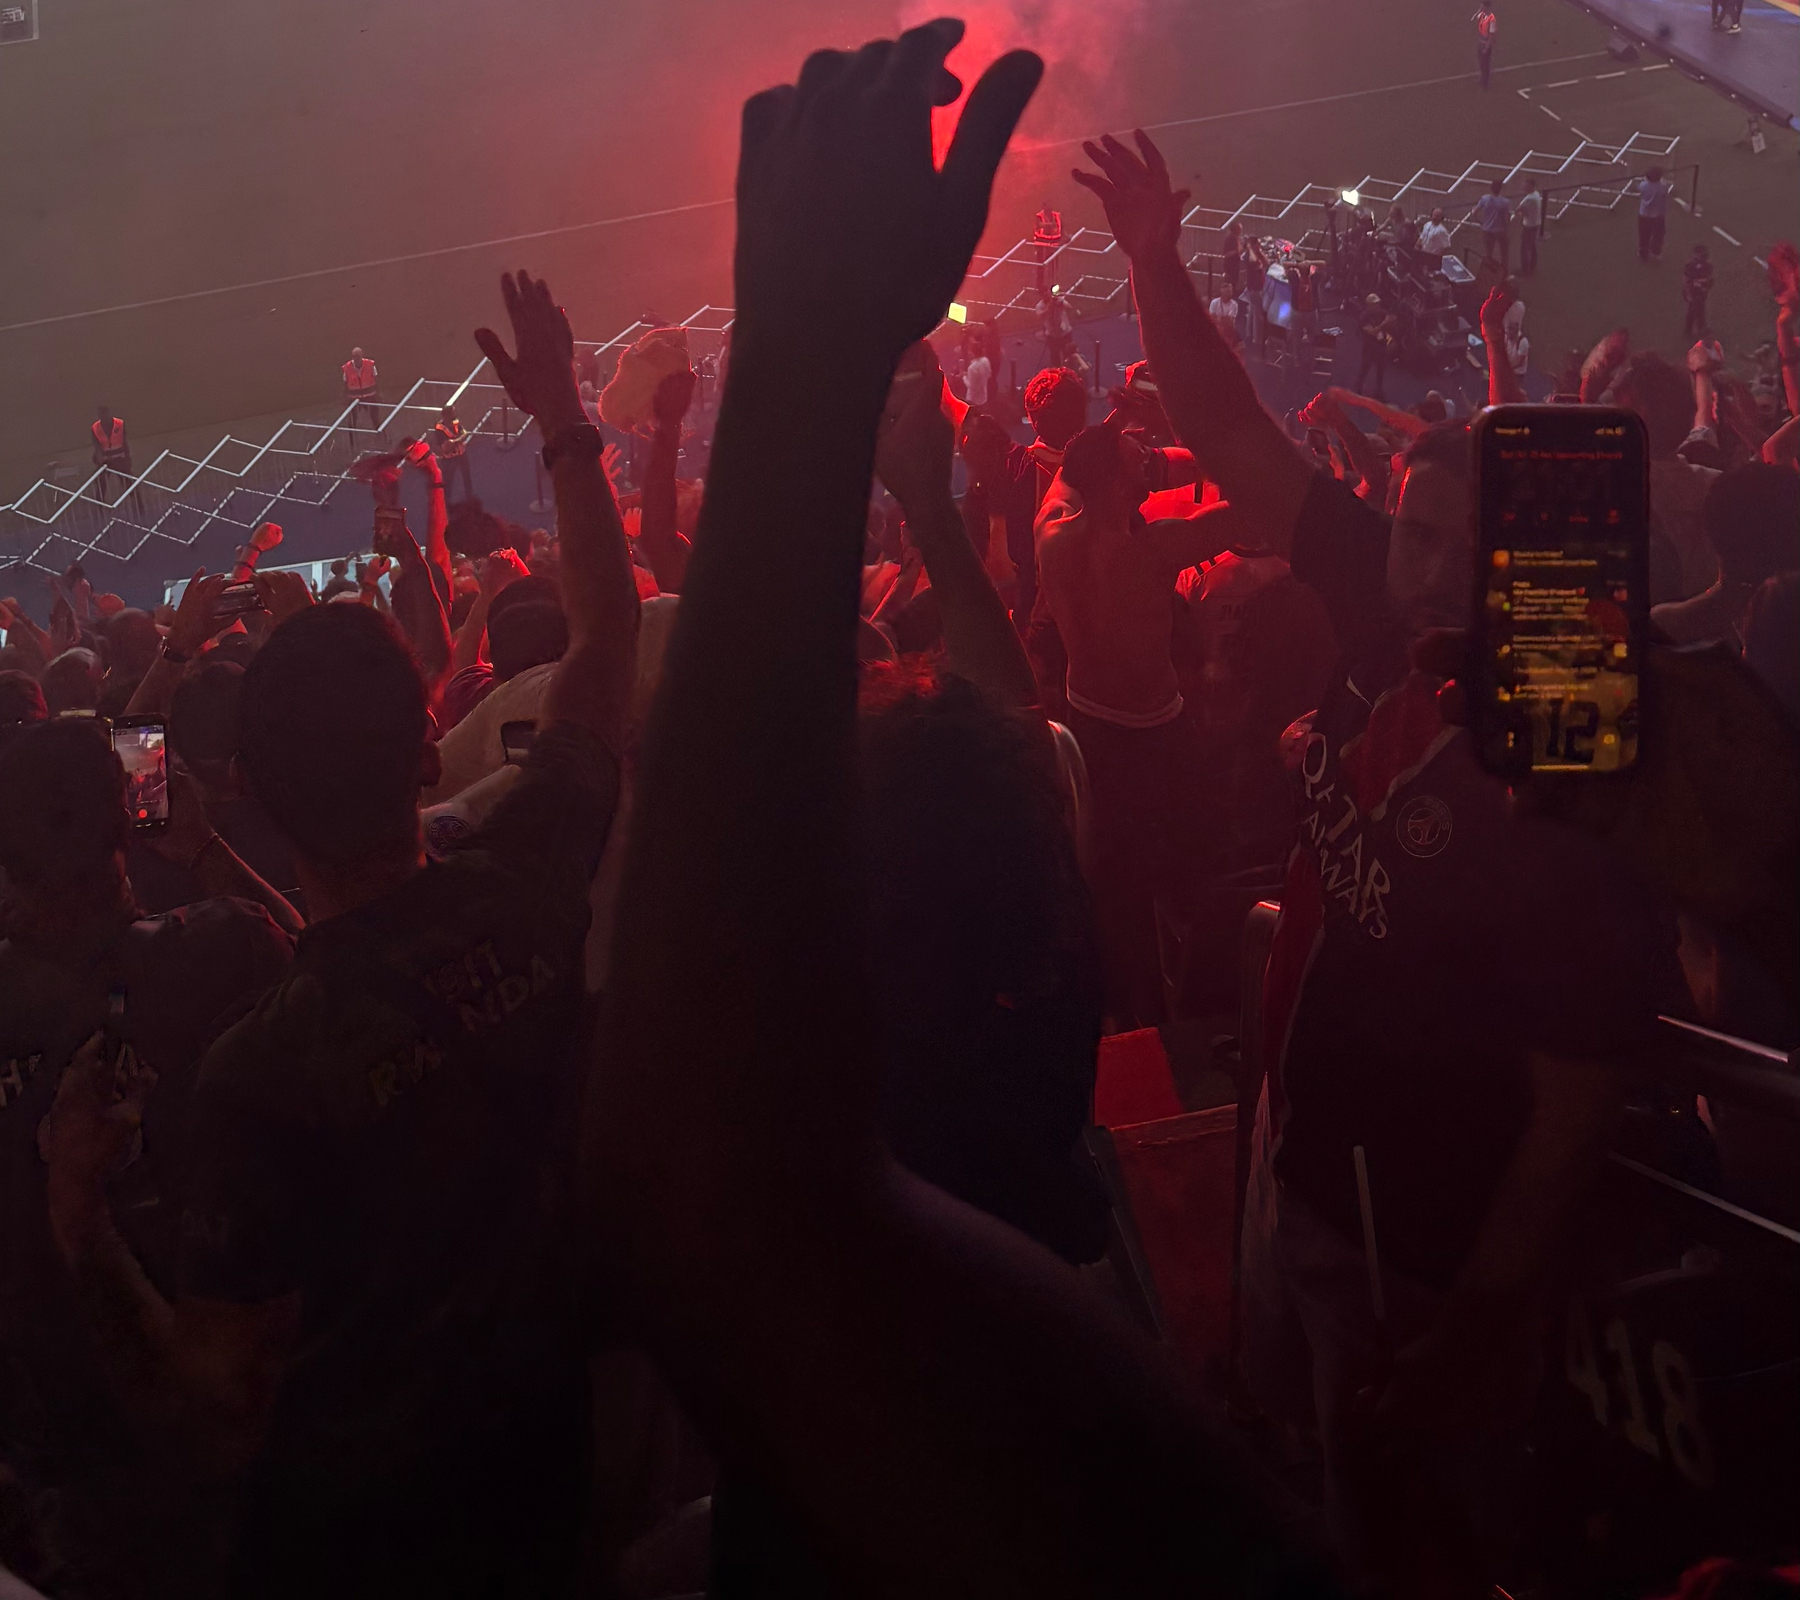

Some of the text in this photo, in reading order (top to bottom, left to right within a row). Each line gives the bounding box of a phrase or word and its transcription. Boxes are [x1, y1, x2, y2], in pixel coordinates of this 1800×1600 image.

[1302, 731, 1390, 923] QATAR
[1302, 810, 1388, 939] AIWAYS
[1565, 1291, 1715, 1490] 418
